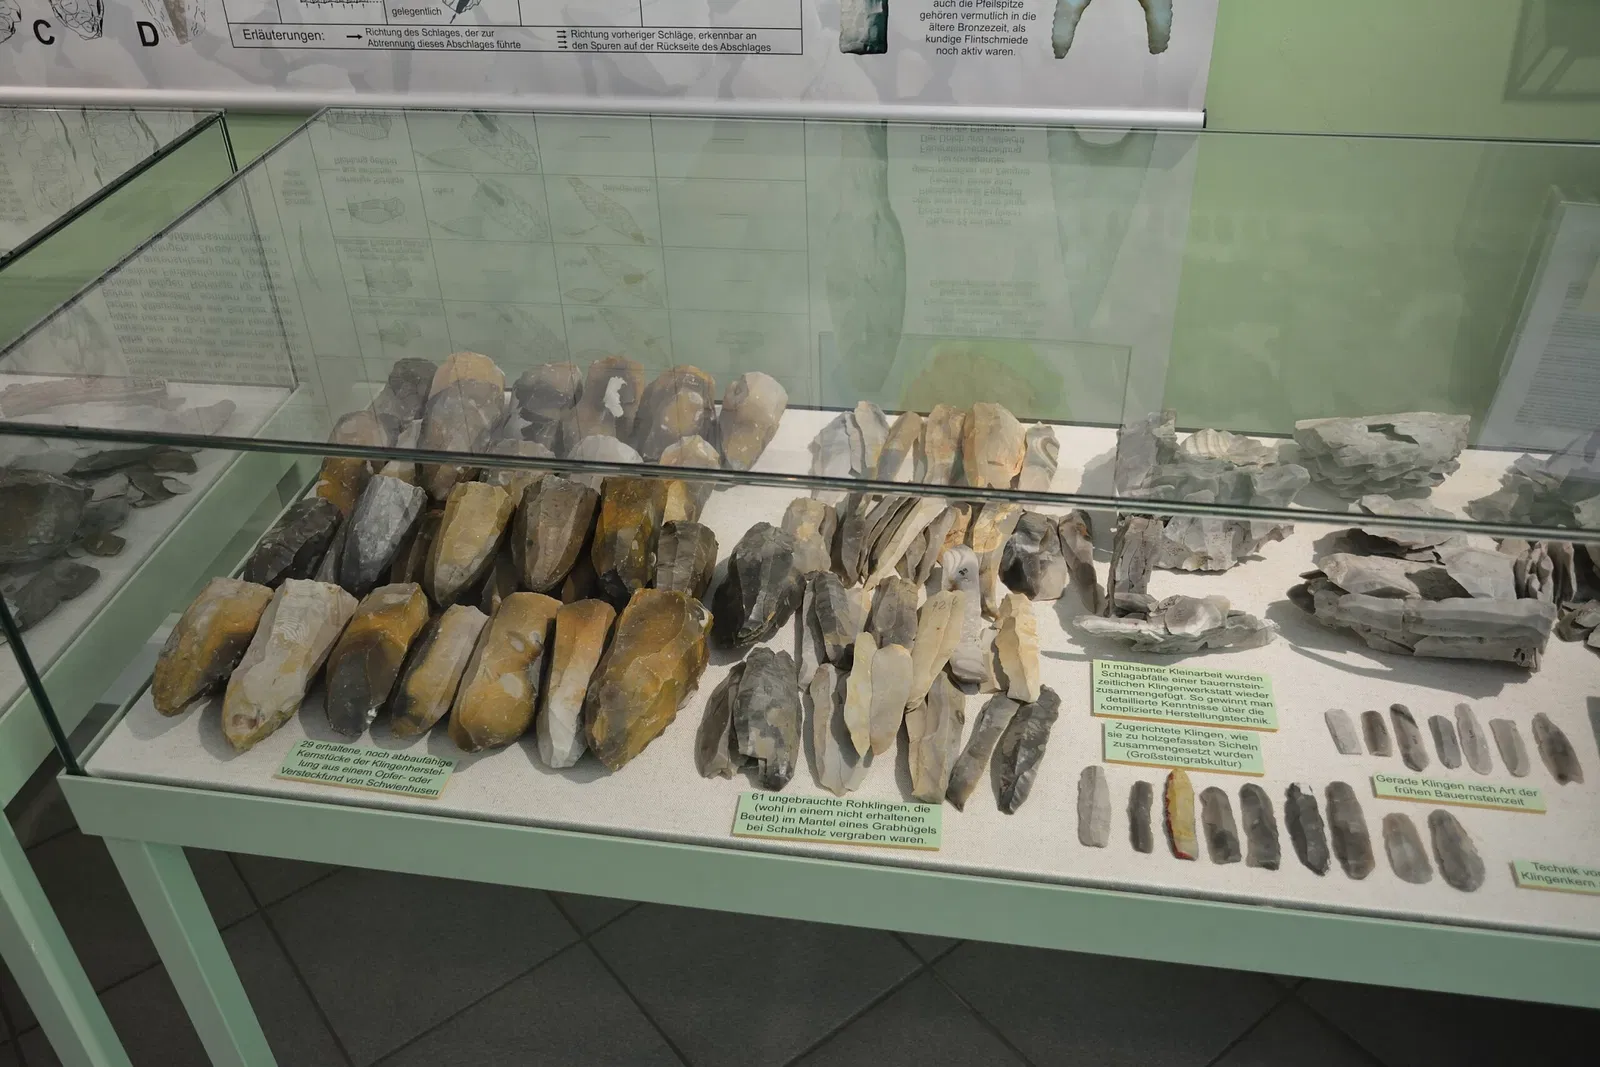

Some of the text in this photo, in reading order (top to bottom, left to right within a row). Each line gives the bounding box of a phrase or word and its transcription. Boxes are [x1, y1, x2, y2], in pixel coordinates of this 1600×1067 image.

[392, 7, 442, 18] gelegentlich
[976, 0, 1024, 10] Pfeilspitze
[920, 11, 1036, 21] gehören vermutlich in die
[33, 20, 55, 45] C
[136, 21, 159, 47] D
[243, 29, 325, 43] Erläuterungen:
[365, 28, 402, 37] Richtung
[422, 29, 463, 38] Schlages,
[465, 29, 479, 37] der
[571, 30, 609, 41] Richtung
[612, 31, 655, 41] vorheriger
[658, 30, 696, 41] Schläge,
[698, 32, 742, 40] erkennbar
[929, 23, 1026, 32] ältere Bronzezeit, als
[368, 40, 521, 50] Abtrennung dieses Abschlages führte
[572, 42, 771, 53] den Spuren auf der Rückseite des Abschlages
[926, 35, 1028, 45] kundige Flintschmiede
[936, 47, 958, 55] noch
[961, 48, 982, 56] aktiv
[1102, 671, 1169, 682] Schlagabfälle
[1201, 679, 1264, 690] bauernstein-
[1113, 664, 1166, 673] mühsamer
[1169, 668, 1223, 679] Kleinarbeit
[1225, 674, 1263, 682] wurden
[1096, 688, 1186, 701] zusammengefügt.
[1207, 697, 1248, 706] gewinnt
[1098, 679, 1269, 699] zeitlichen Klingenwerkstatt wieder
[1101, 704, 1271, 724] komplizierte Herstellungstechnik.
[1106, 696, 1158, 706] detaillierte
[1161, 701, 1219, 712] Kenntnisse
[1222, 706, 1245, 714] über
[1115, 723, 1180, 735] Zugerichtete
[1184, 729, 1227, 740] Klingen,
[1113, 742, 1254, 760] zusammengesetzt wurden
[1142, 734, 1216, 747] holzgefassten
[1219, 741, 1258, 751] Sicheln
[296, 749, 445, 776] Kernstücke der Klingenherstel-
[300, 740, 452, 768] 29 erhaltene, noch abbaufähige
[1126, 751, 1242, 769] (Großsteingrabkultur)
[281, 767, 439, 796] Versteckfund von Schwienhusen
[298, 760, 432, 785] lung aus einem Opfer- oder
[1376, 775, 1538, 797] Gerade Klingen nach Art der
[752, 793, 930, 813] 61 ungebrauchte Rohklingen, die
[1395, 786, 1524, 806] frühen Bauernsteinzeit
[755, 804, 924, 823] (wohl in einem nicht erhaltenen
[740, 812, 937, 835] Beutel) im Mantel eines Grabhügels
[747, 823, 927, 845] bei Schalkholz vergraben waren.
[1532, 862, 1579, 876] Technik
[1521, 872, 1592, 888] Klingenkern
